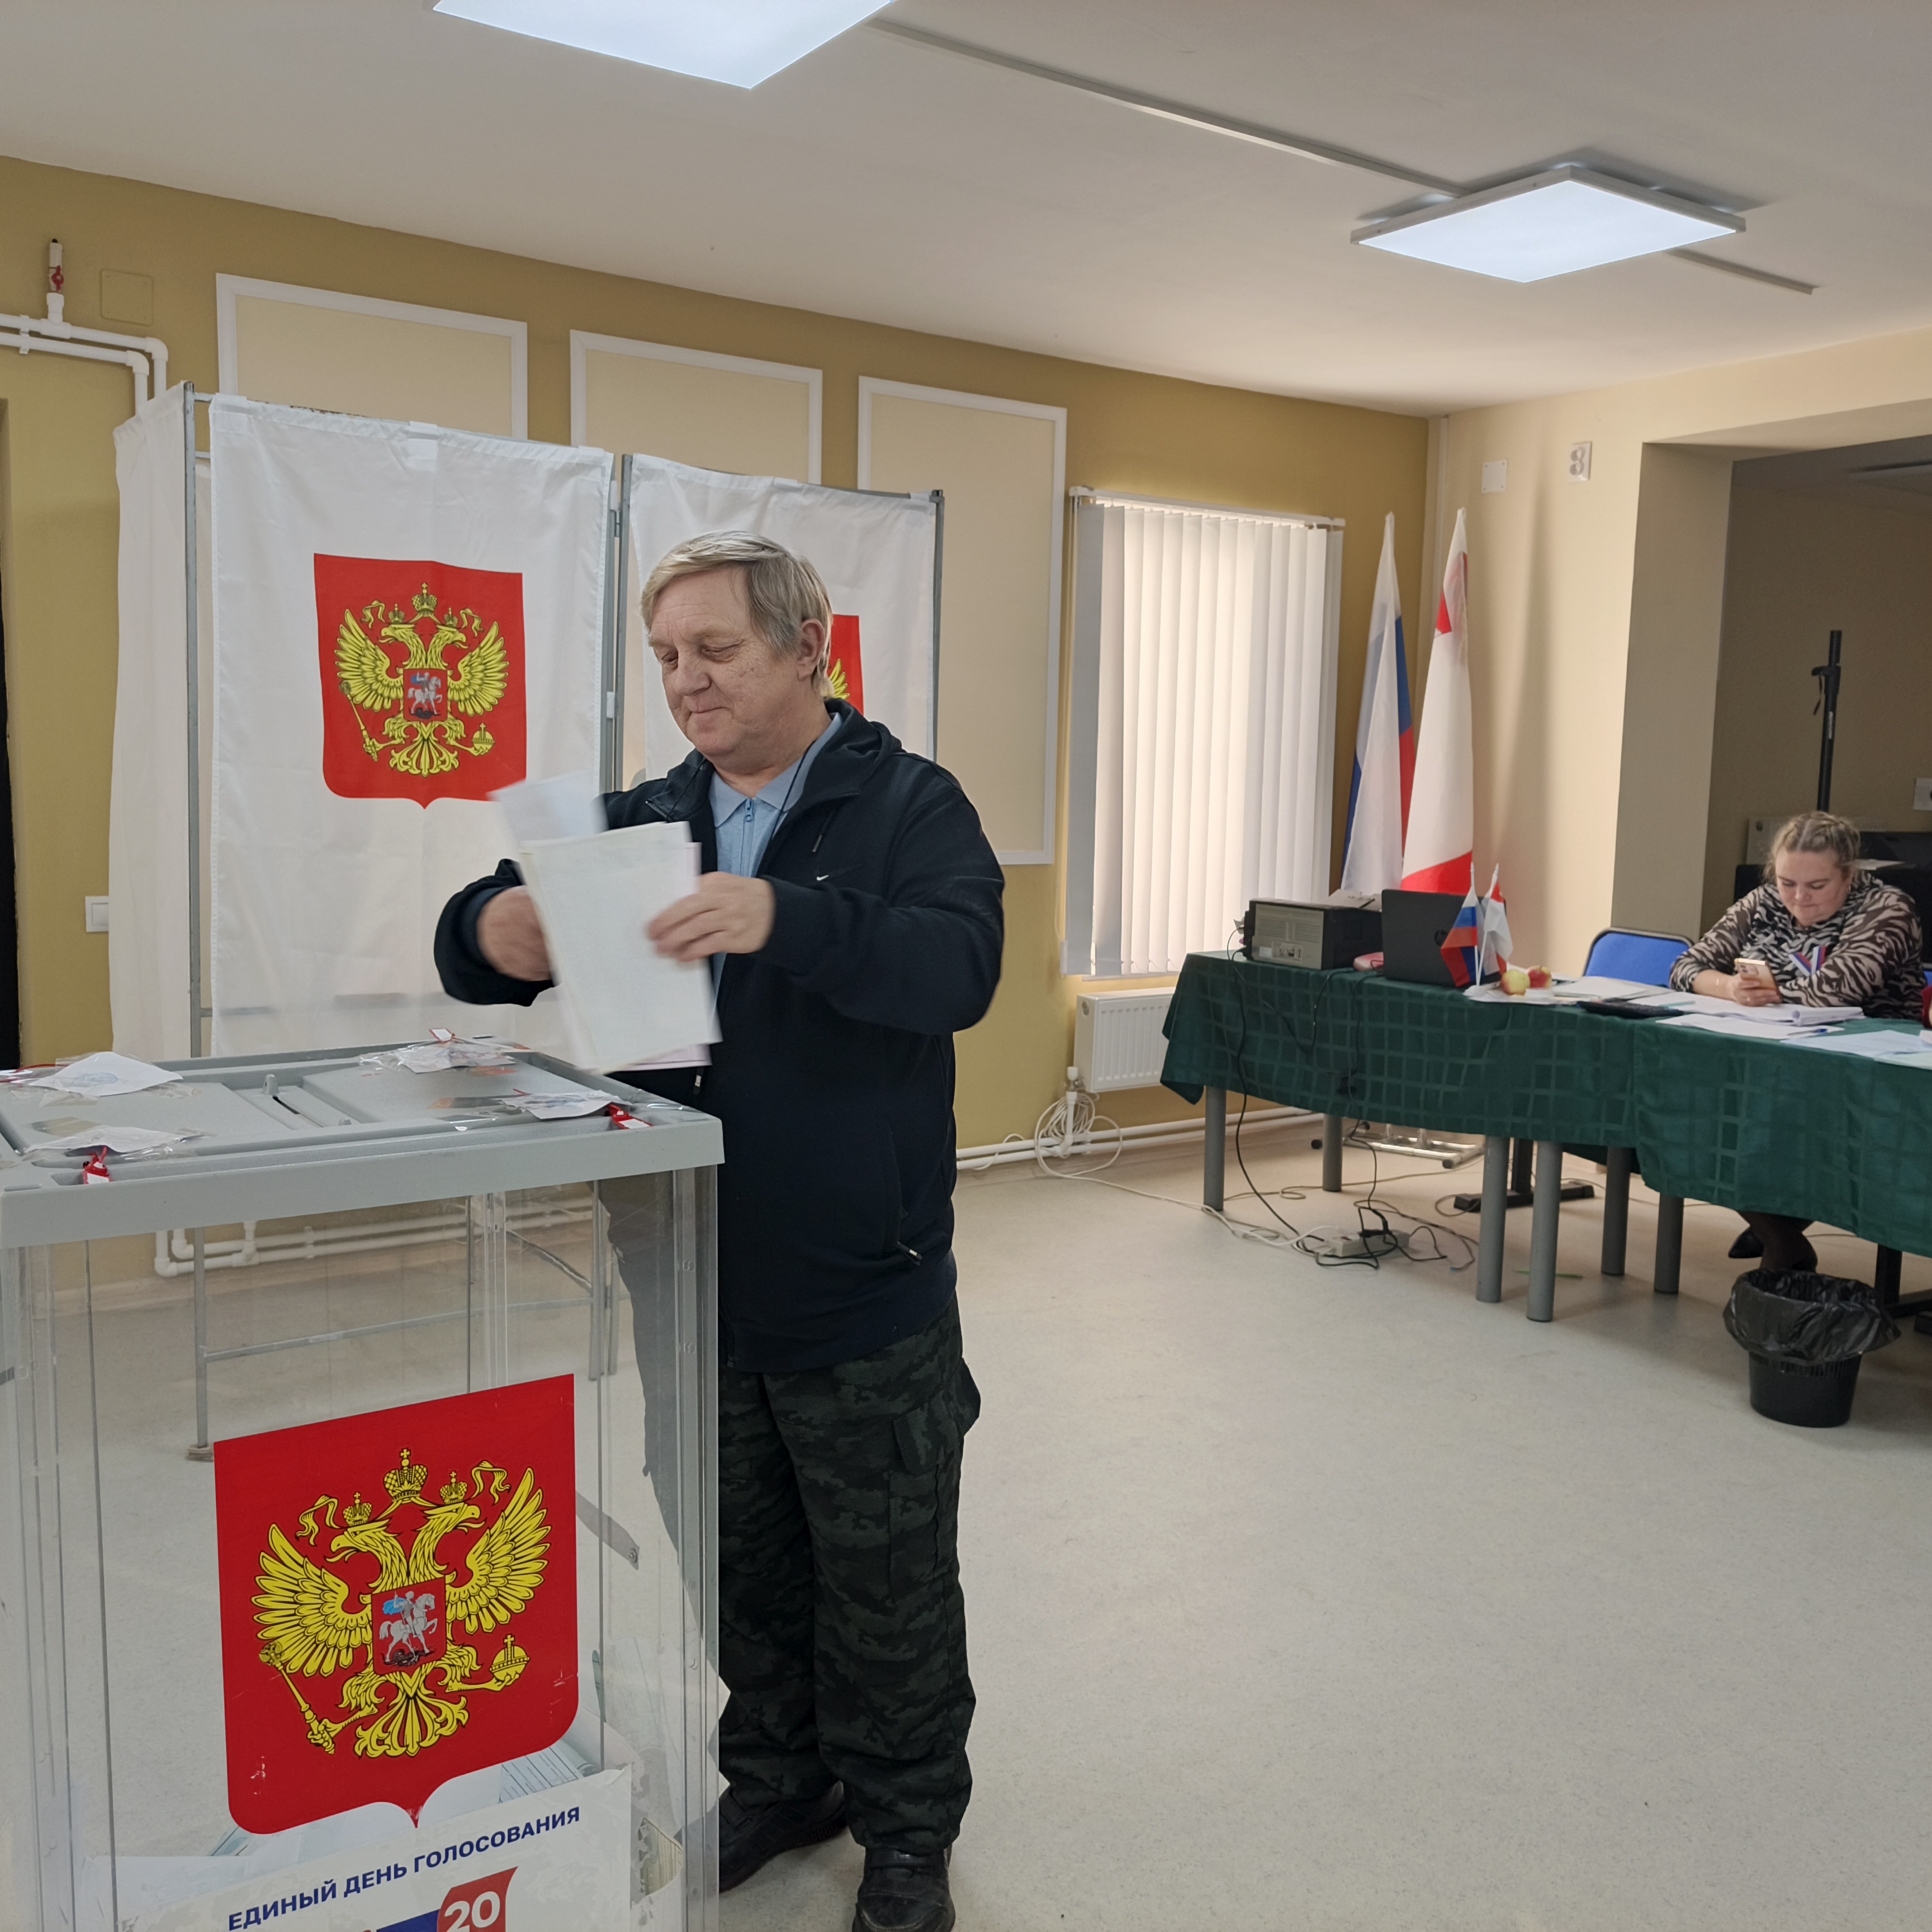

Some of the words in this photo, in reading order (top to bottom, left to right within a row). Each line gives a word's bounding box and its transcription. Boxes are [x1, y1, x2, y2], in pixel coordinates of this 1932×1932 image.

[229, 1879, 337, 1931] ЕДИНЫЙ
[343, 1863, 407, 1898] ДЕНЬ
[414, 1806, 579, 1873] ГОЛОСОВАНИЯ
[444, 1891, 500, 1932] 20
